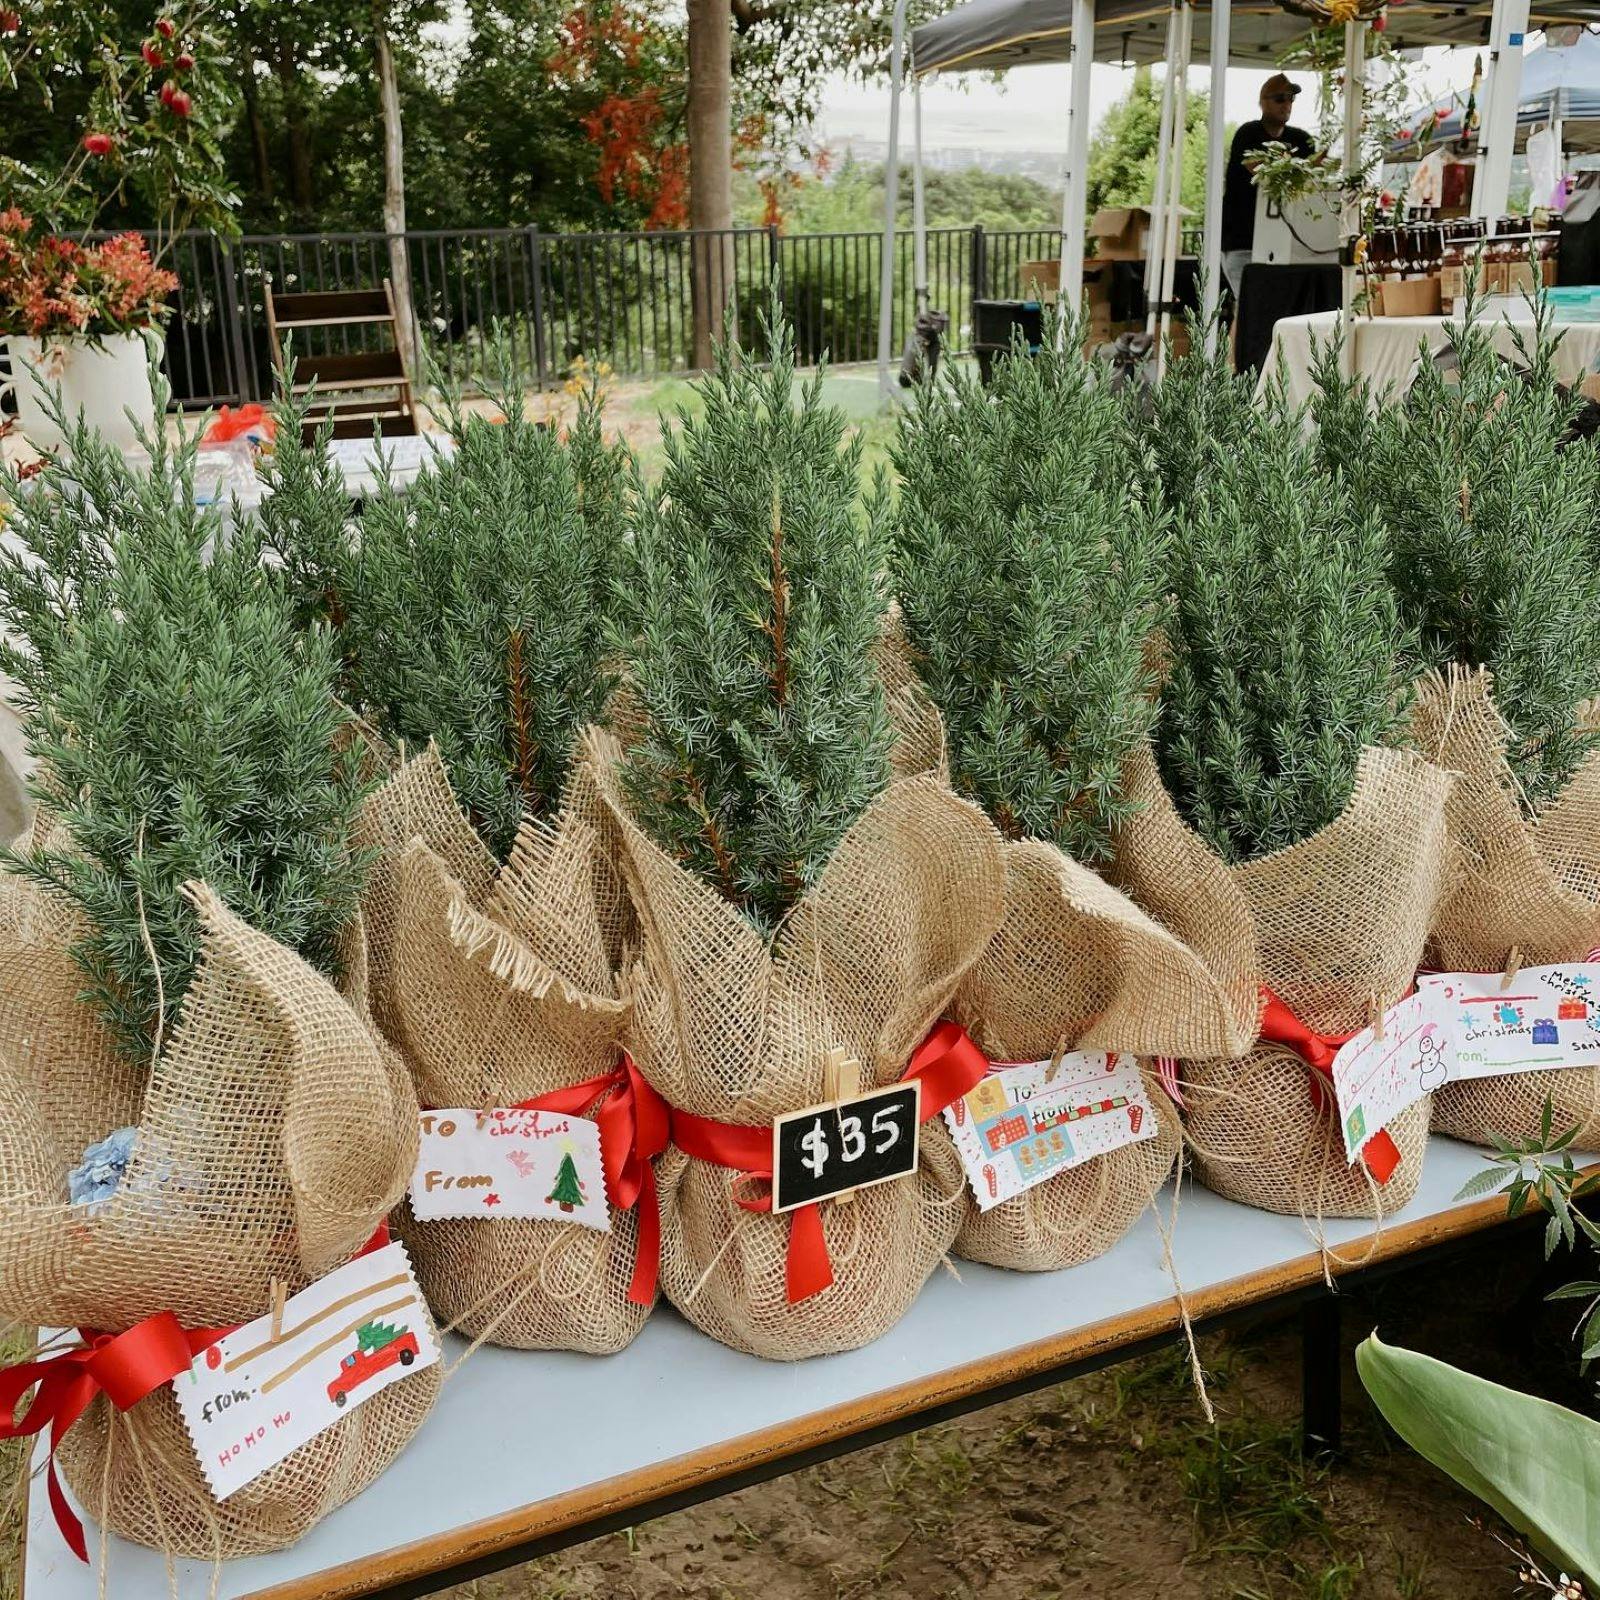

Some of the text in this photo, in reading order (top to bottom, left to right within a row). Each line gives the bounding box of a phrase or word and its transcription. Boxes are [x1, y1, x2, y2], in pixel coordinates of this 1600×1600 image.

[1547, 971, 1592, 996] Merry
[1465, 1024, 1532, 1041] christmas
[1456, 1047, 1488, 1062] rom:
[490, 1120, 569, 1140] christmas
[801, 1105, 904, 1179] $35
[425, 1171, 494, 1192] From
